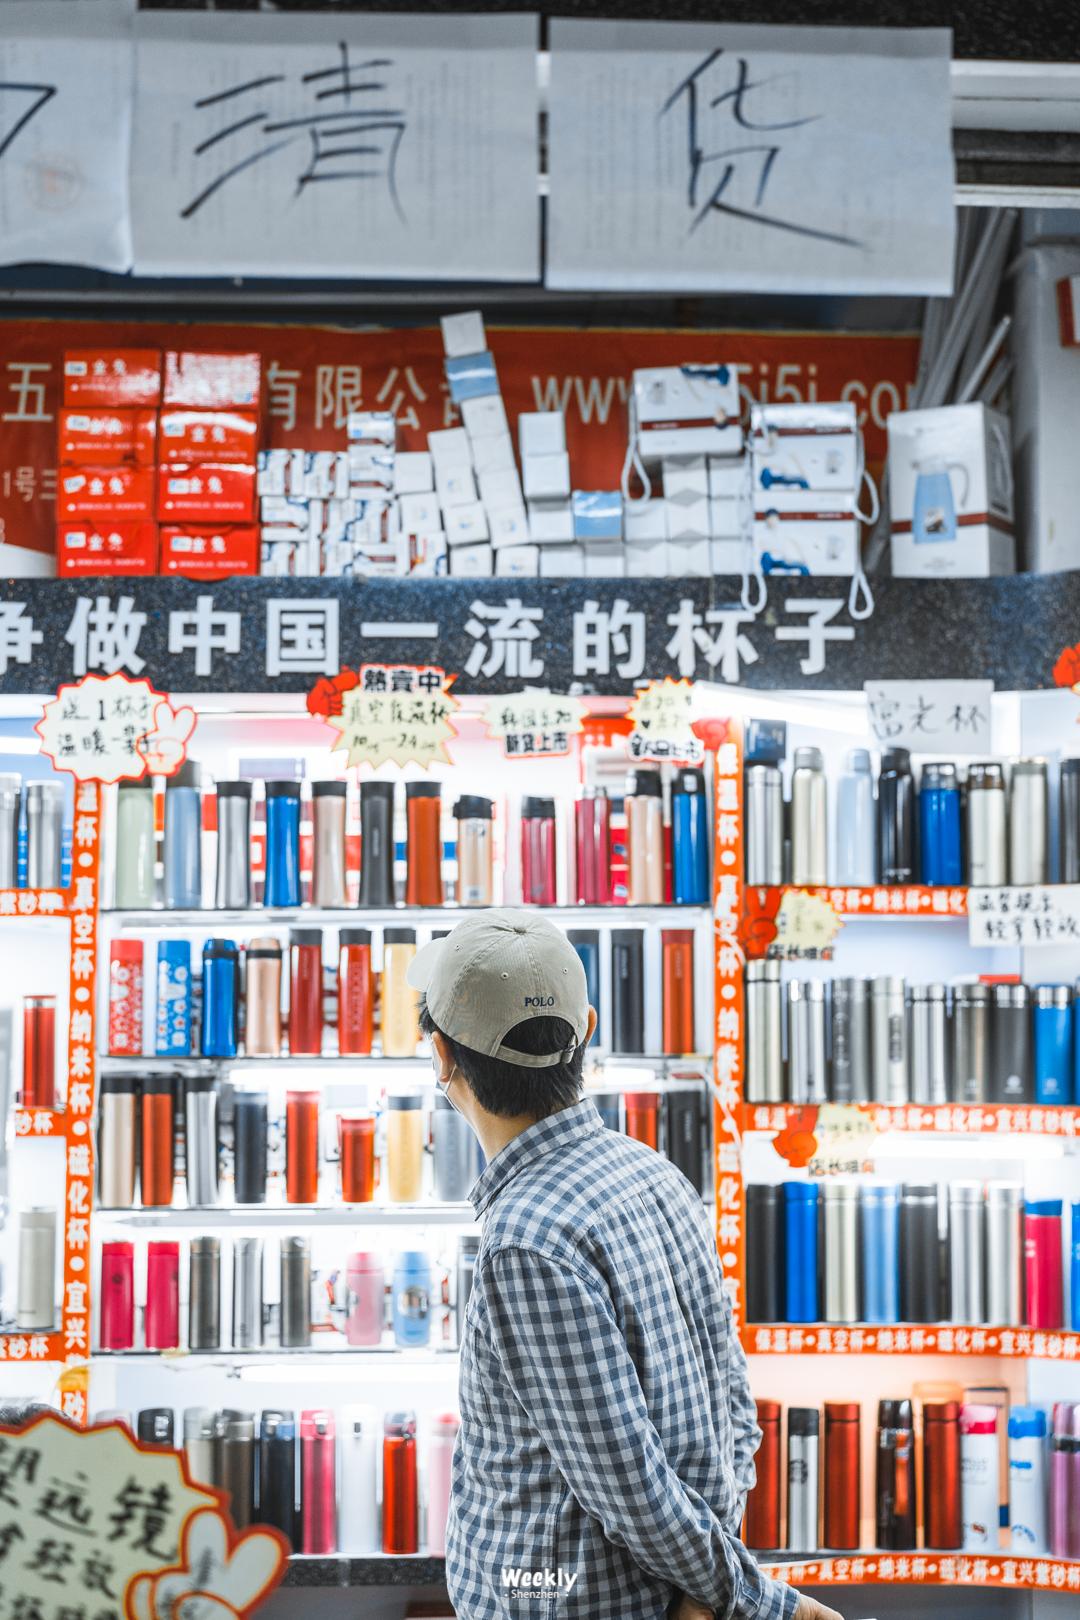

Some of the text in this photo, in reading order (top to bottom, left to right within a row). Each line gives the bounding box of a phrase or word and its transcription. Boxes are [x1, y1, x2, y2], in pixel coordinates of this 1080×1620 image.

[180, 41, 875, 252] 清 货
[0, 596, 855, 682] 争做中国一流的杯子
[524, 996, 554, 1007] POLO
